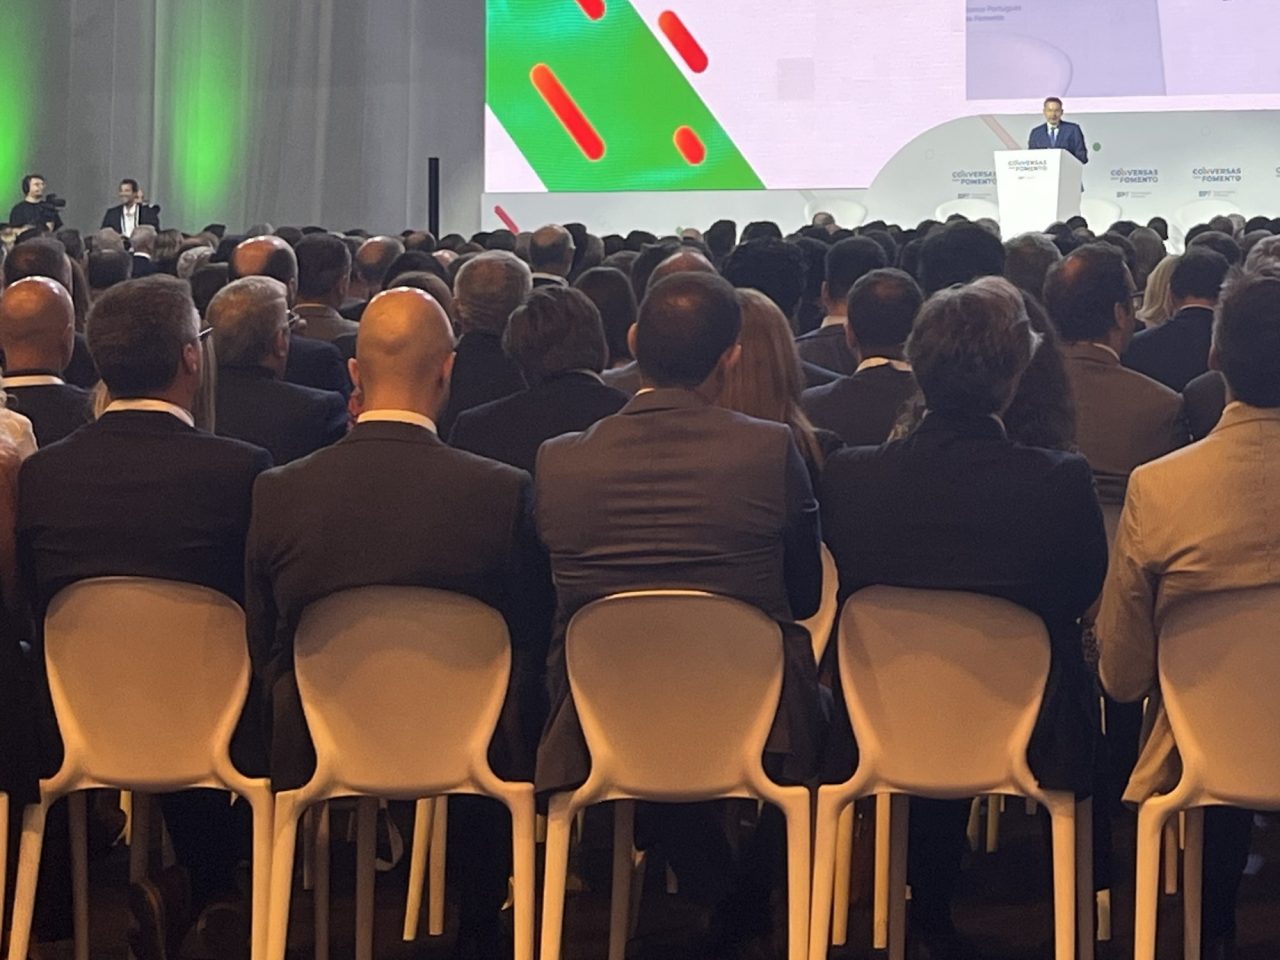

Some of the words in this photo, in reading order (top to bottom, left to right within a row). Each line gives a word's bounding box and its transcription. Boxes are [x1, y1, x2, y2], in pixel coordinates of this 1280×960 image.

[1110, 167, 1159, 177] CONVERSAS
[1192, 166, 1242, 175] CONVERSAS
[1119, 176, 1159, 184] FOMENTO
